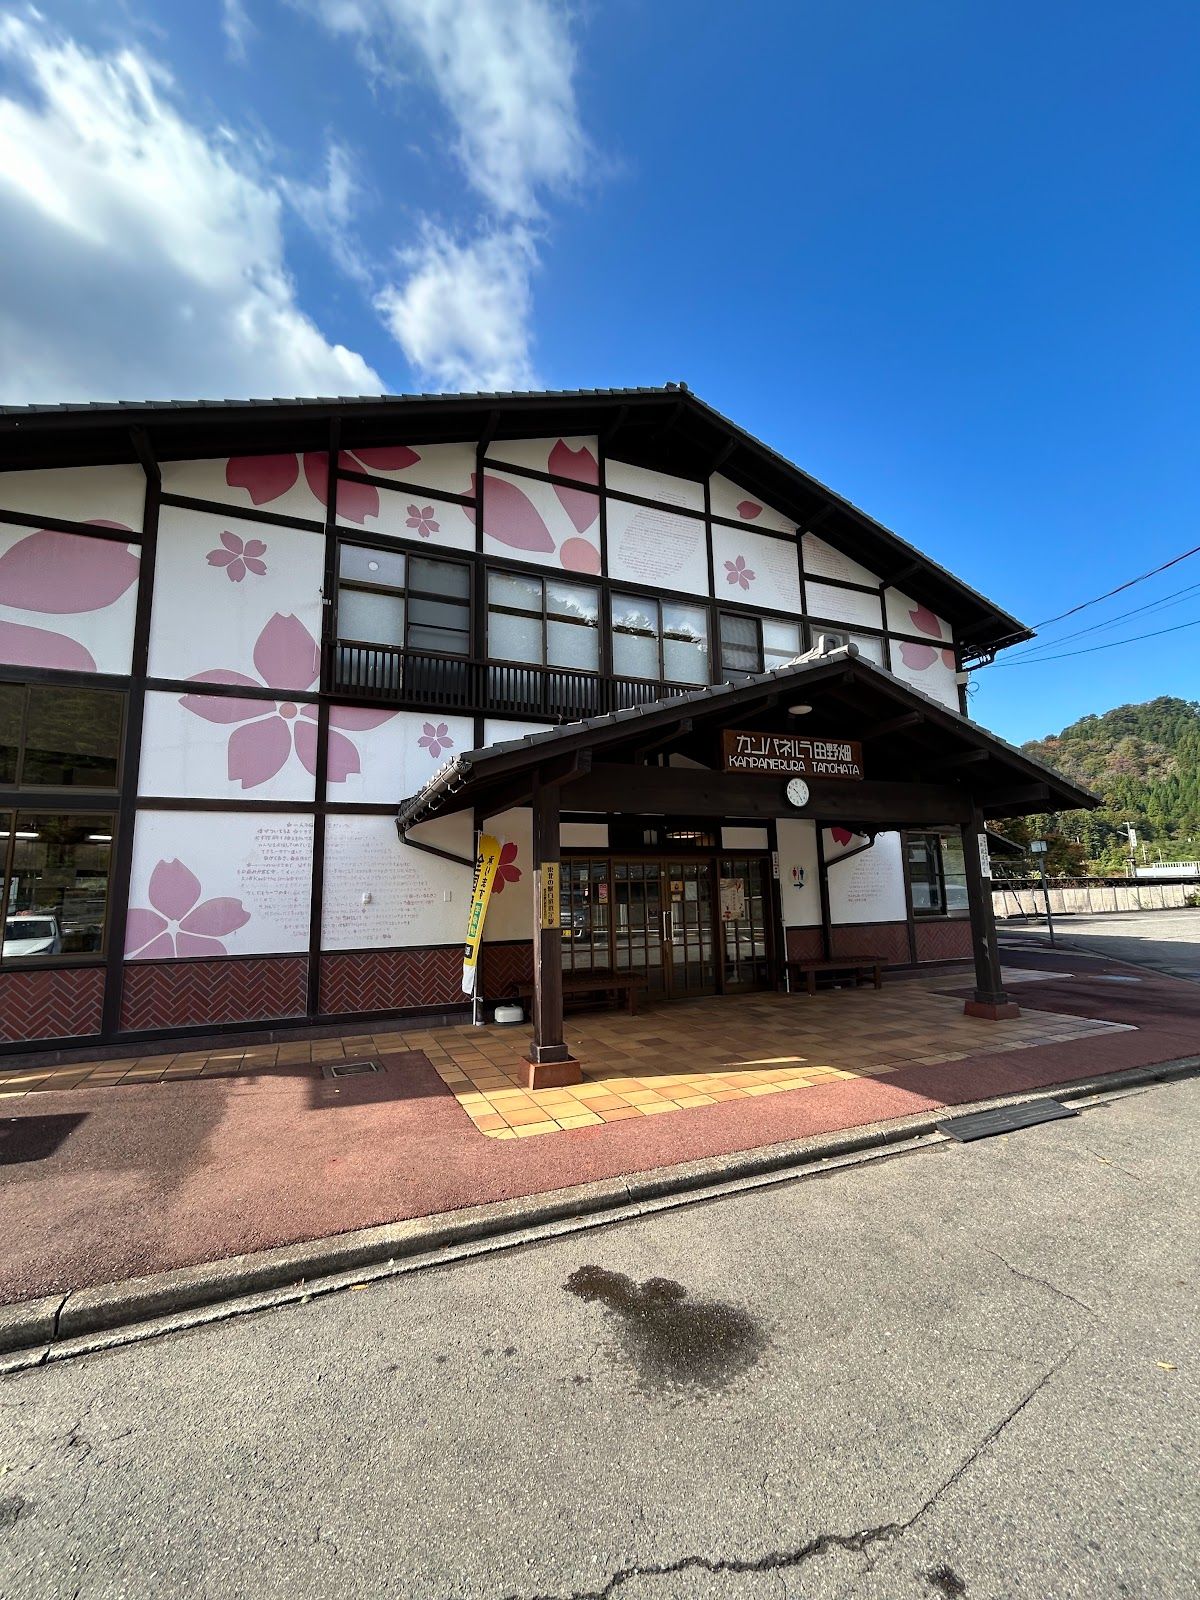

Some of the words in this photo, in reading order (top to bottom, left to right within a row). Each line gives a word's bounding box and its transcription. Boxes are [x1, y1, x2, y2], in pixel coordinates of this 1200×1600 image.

[736, 735, 852, 762] カンパネルラ田野畑
[728, 755, 806, 771] KANPANERURA
[811, 761, 860, 775] TANOHATA
